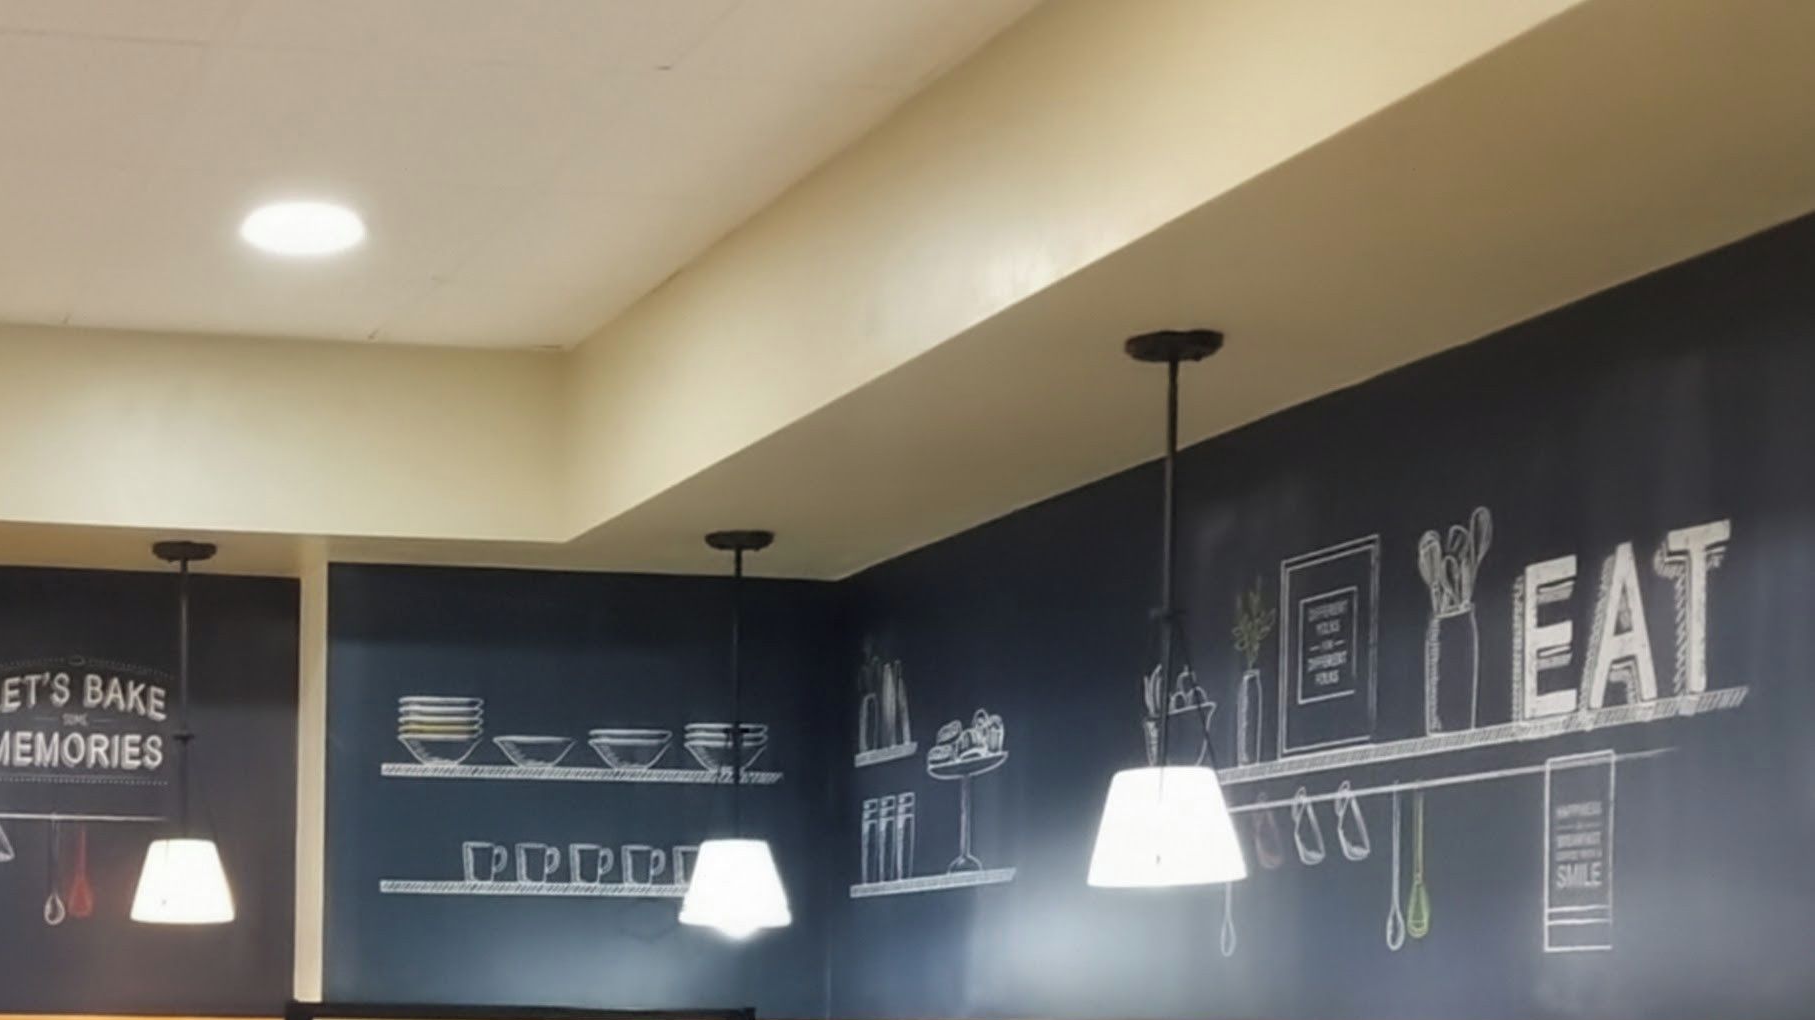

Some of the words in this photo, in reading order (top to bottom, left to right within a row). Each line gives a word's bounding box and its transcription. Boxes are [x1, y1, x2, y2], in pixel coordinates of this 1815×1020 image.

[1512, 518, 1731, 722] EAT
[83, 673, 167, 721] BAKE
[1556, 861, 1603, 889] SMILE
